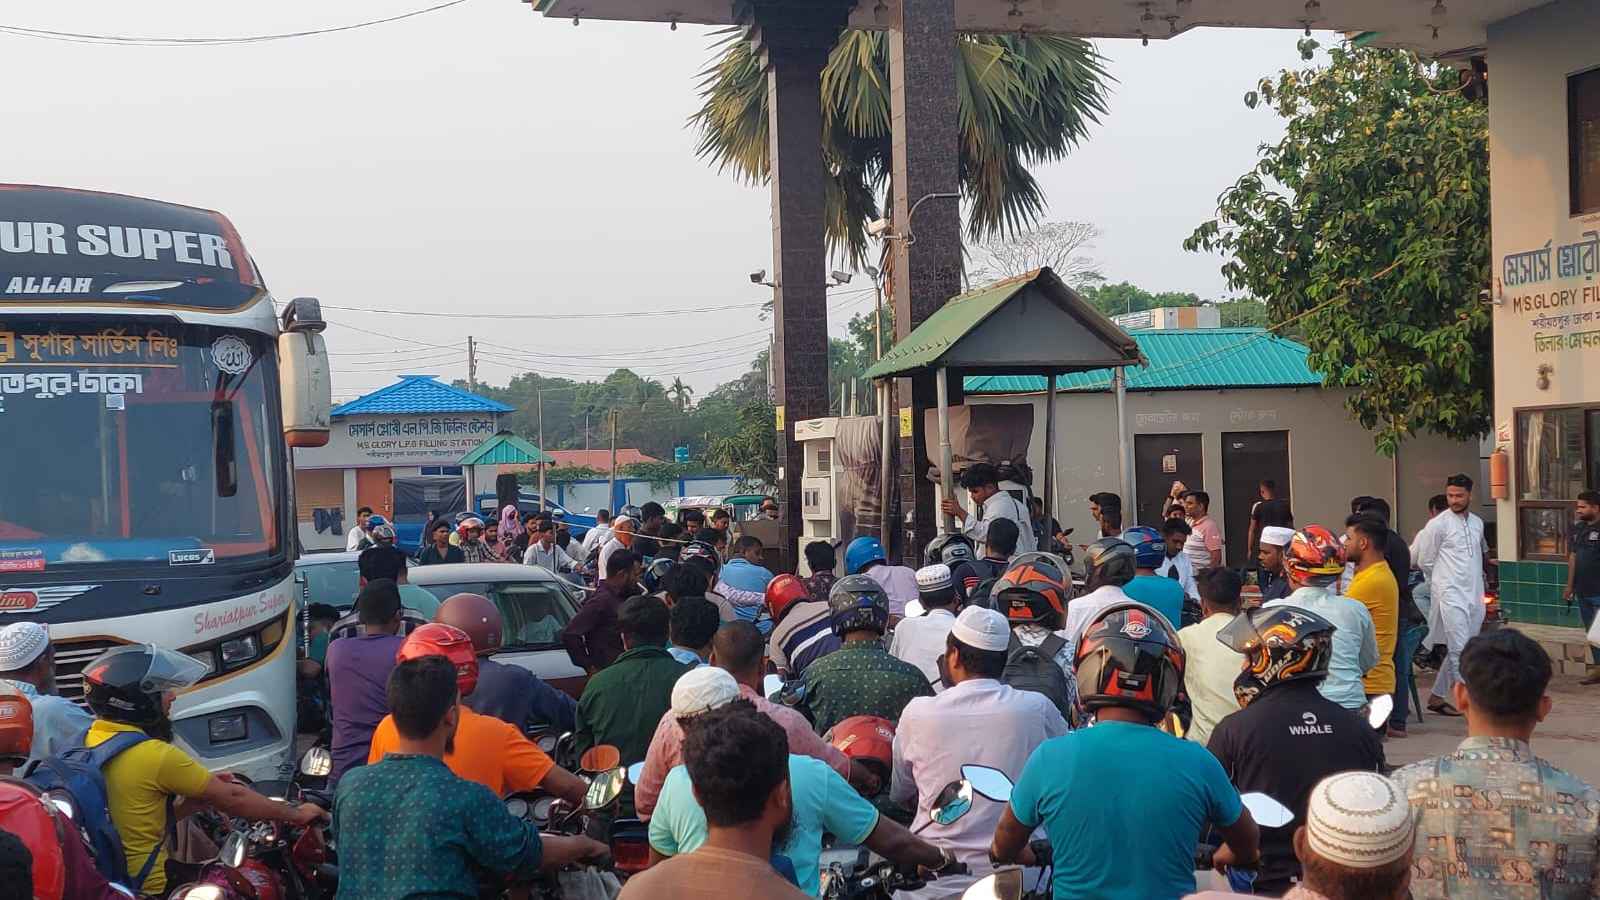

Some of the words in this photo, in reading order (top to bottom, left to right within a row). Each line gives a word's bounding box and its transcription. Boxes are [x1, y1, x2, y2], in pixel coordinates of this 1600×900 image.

[76, 224, 234, 270] SUPER
[5, 276, 93, 295] ALLAH
[371, 439, 397, 448] GLORY
[419, 439, 448, 448] FILLING
[171, 552, 201, 562] Lucas
[1289, 725, 1333, 735] WHALE
